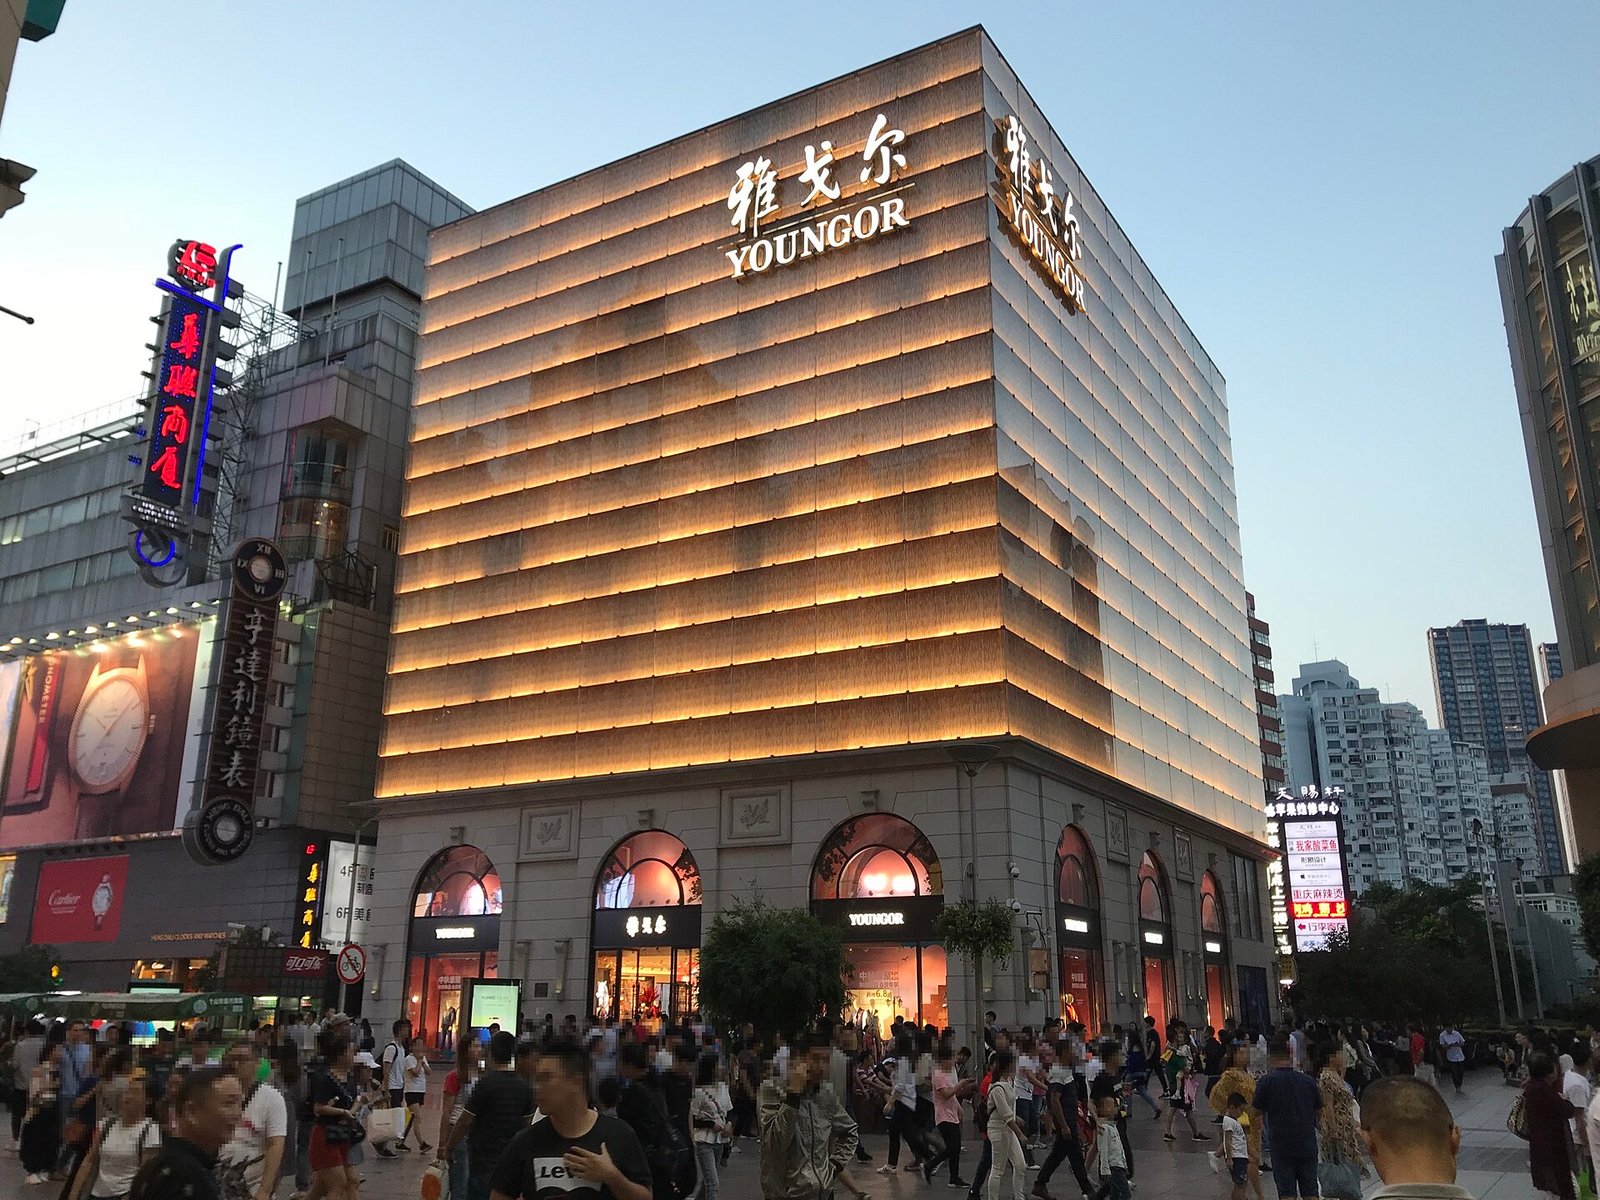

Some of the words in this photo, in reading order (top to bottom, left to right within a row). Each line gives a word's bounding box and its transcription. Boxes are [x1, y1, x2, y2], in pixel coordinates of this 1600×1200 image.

[728, 113, 906, 238] 雅戈尔
[1006, 115, 1082, 261] 雅戈尔
[725, 198, 910, 279] YOUNGOR
[1009, 190, 1087, 313] YOUNGOR
[48, 889, 81, 906] Cartier
[849, 912, 905, 926] YOUNGOR
